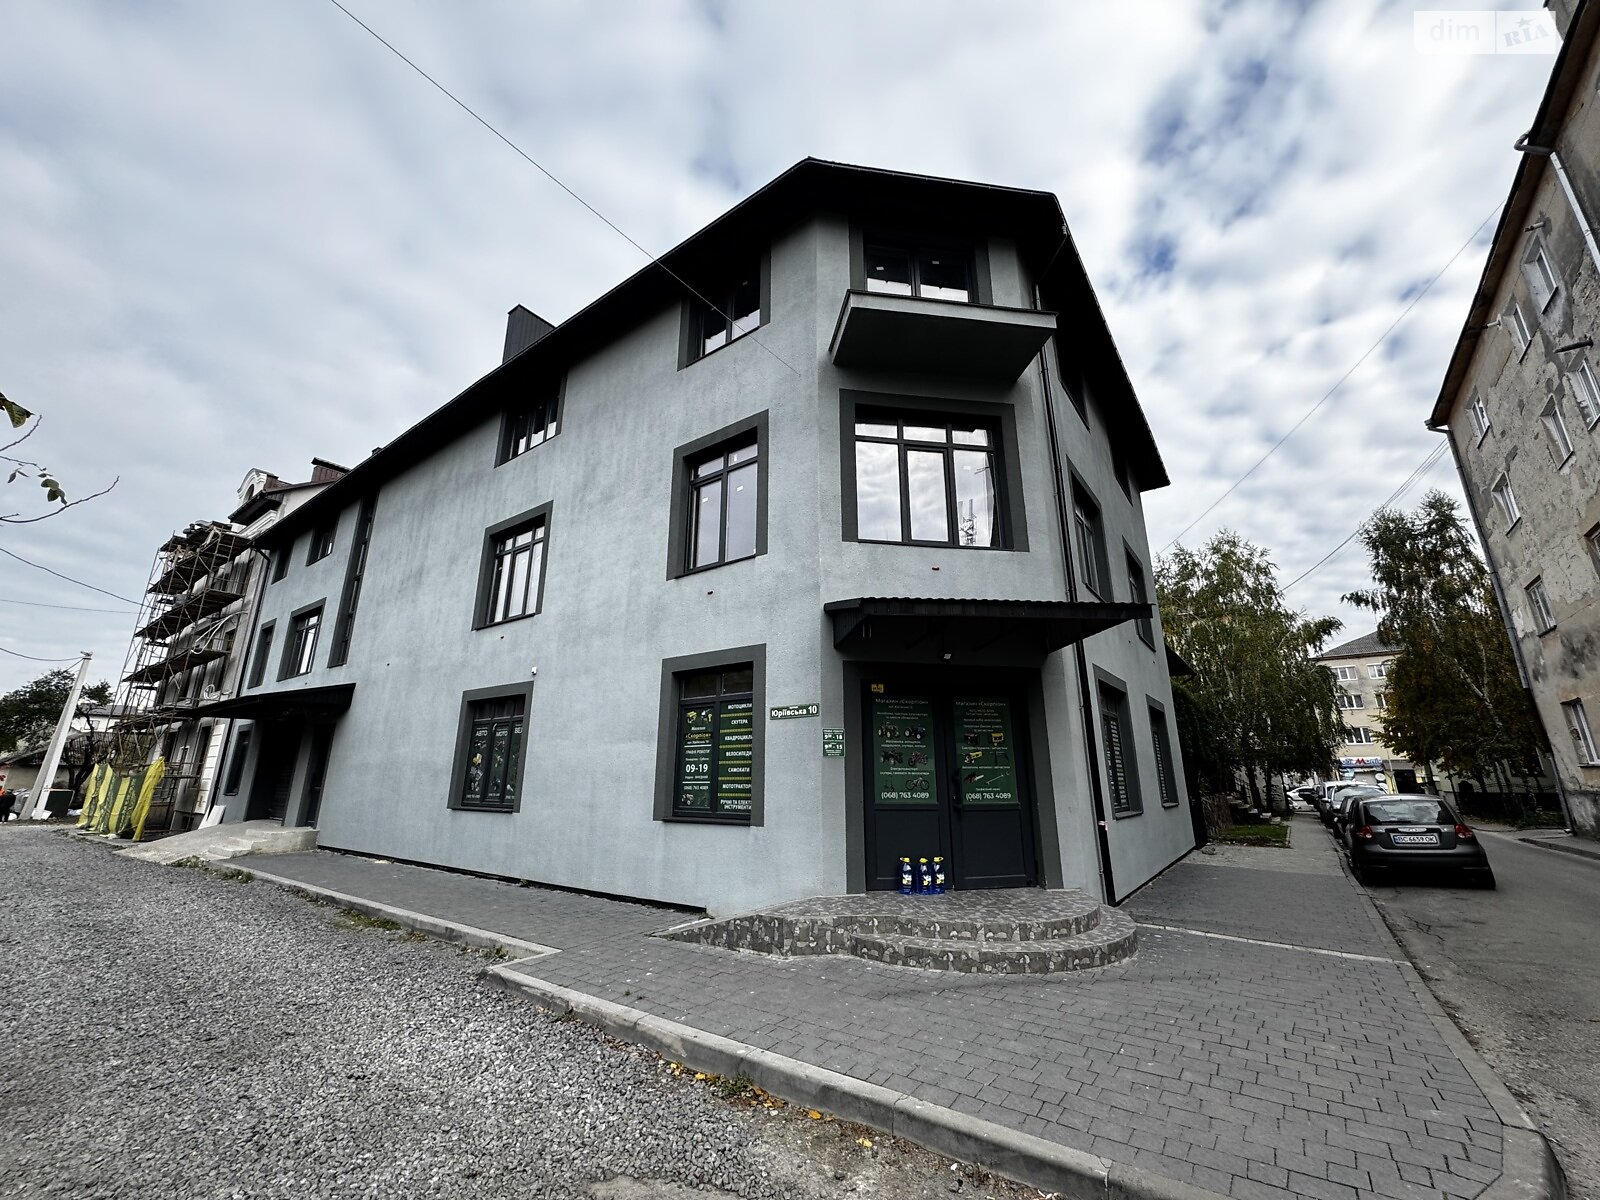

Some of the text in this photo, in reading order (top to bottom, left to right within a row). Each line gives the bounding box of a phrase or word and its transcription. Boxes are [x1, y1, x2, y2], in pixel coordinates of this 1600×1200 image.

[771, 708, 807, 718] Юріївська
[808, 705, 818, 714] 10
[685, 763, 709, 773] 09-19
[881, 791, 930, 800] (068) 763 4089
[965, 793, 982, 801] (068)
[995, 792, 1012, 800] 4089
